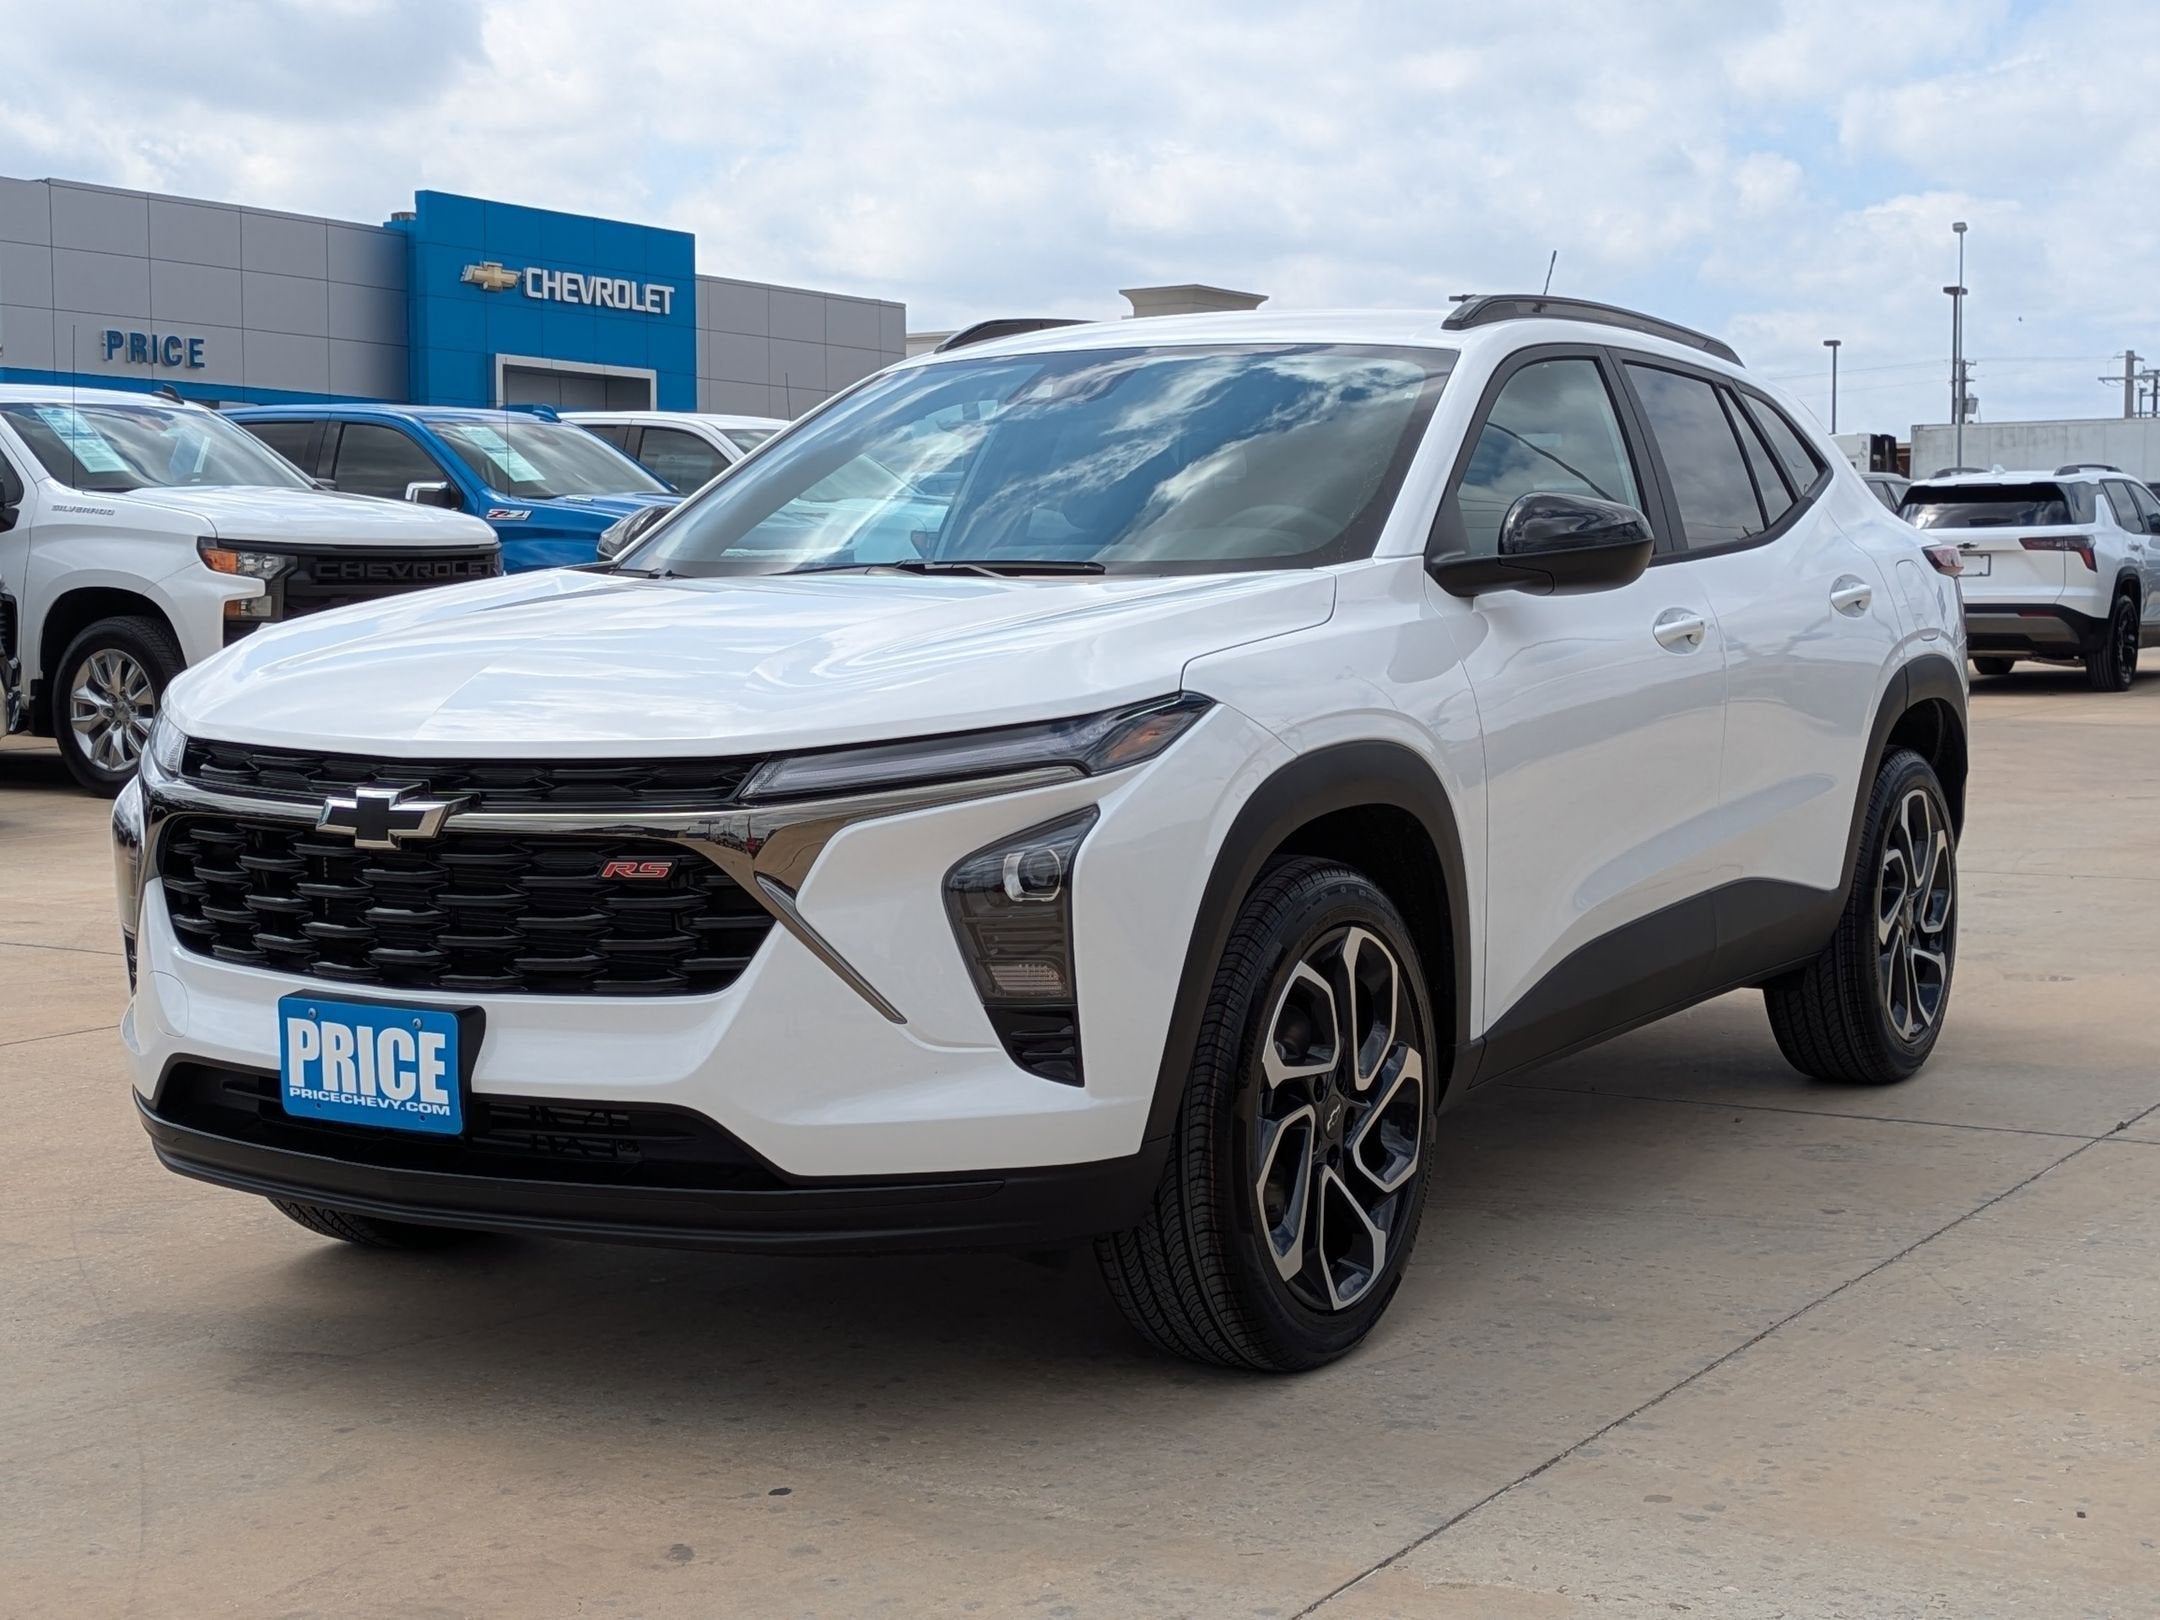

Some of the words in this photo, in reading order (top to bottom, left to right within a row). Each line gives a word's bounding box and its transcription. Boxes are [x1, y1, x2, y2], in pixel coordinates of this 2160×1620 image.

[525, 266, 675, 315] CHEVROLET
[103, 329, 206, 369] PRICE
[315, 561, 496, 579] CHEVROLET
[601, 861, 673, 878] RS
[287, 1017, 449, 1105] PRICE
[289, 1086, 451, 1116] PRICECHEVY.COM
